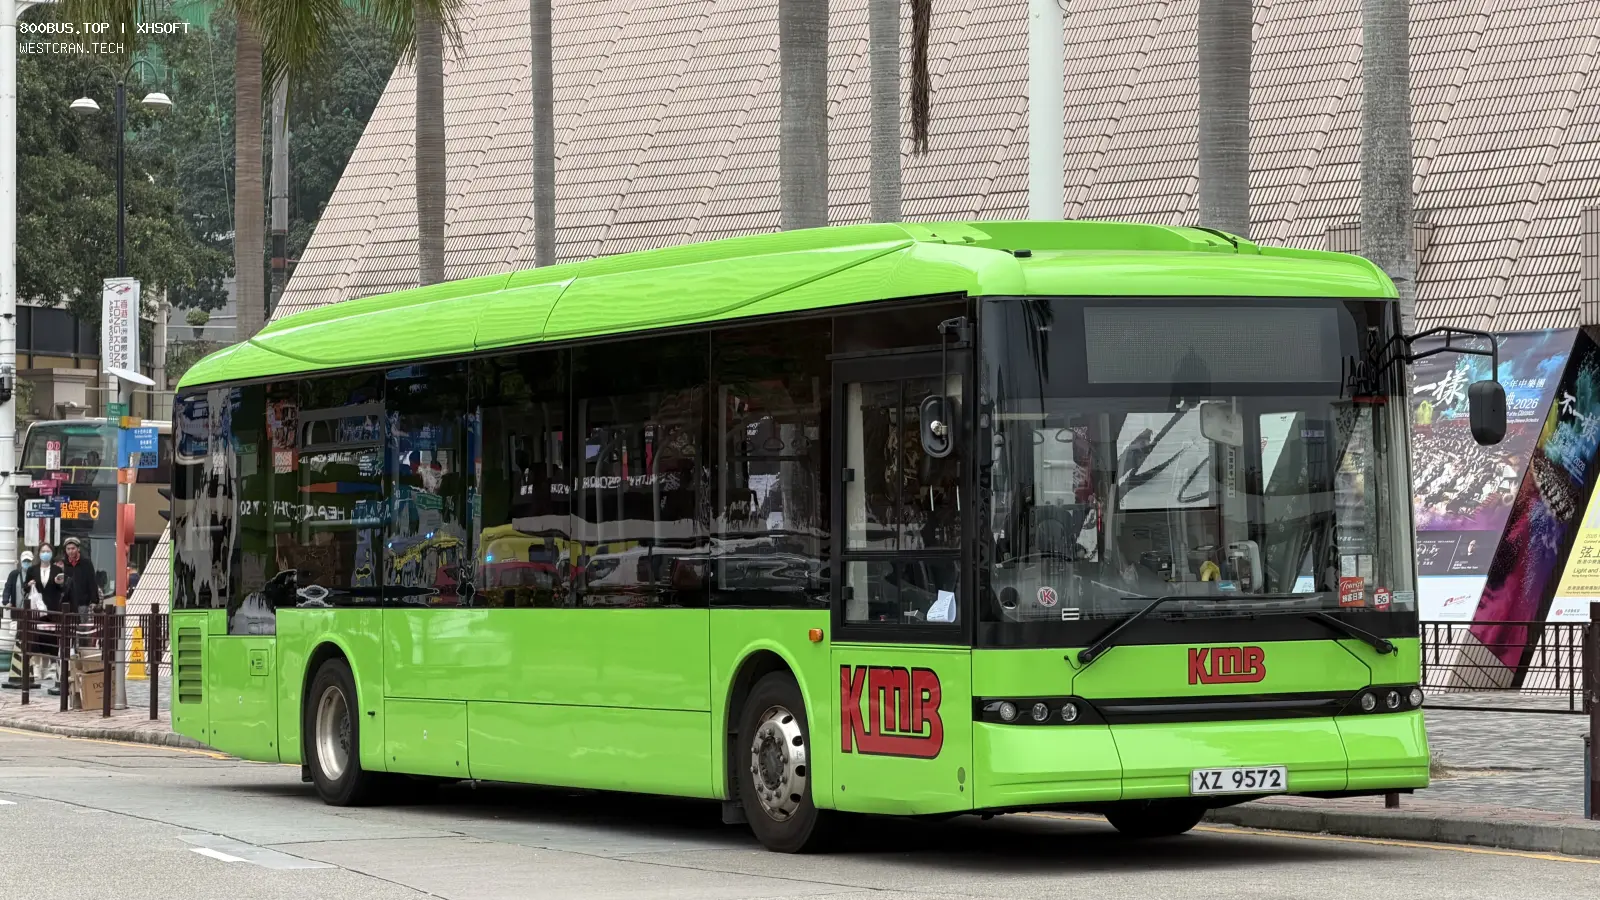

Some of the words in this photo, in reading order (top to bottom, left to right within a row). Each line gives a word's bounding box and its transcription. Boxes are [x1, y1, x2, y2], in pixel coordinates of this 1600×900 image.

[90, 501, 100, 519] 6
[1188, 646, 1267, 685] KMB
[839, 664, 944, 760] KMB
[1197, 771, 1224, 790] XZ
[1232, 769, 1282, 788] 9572
